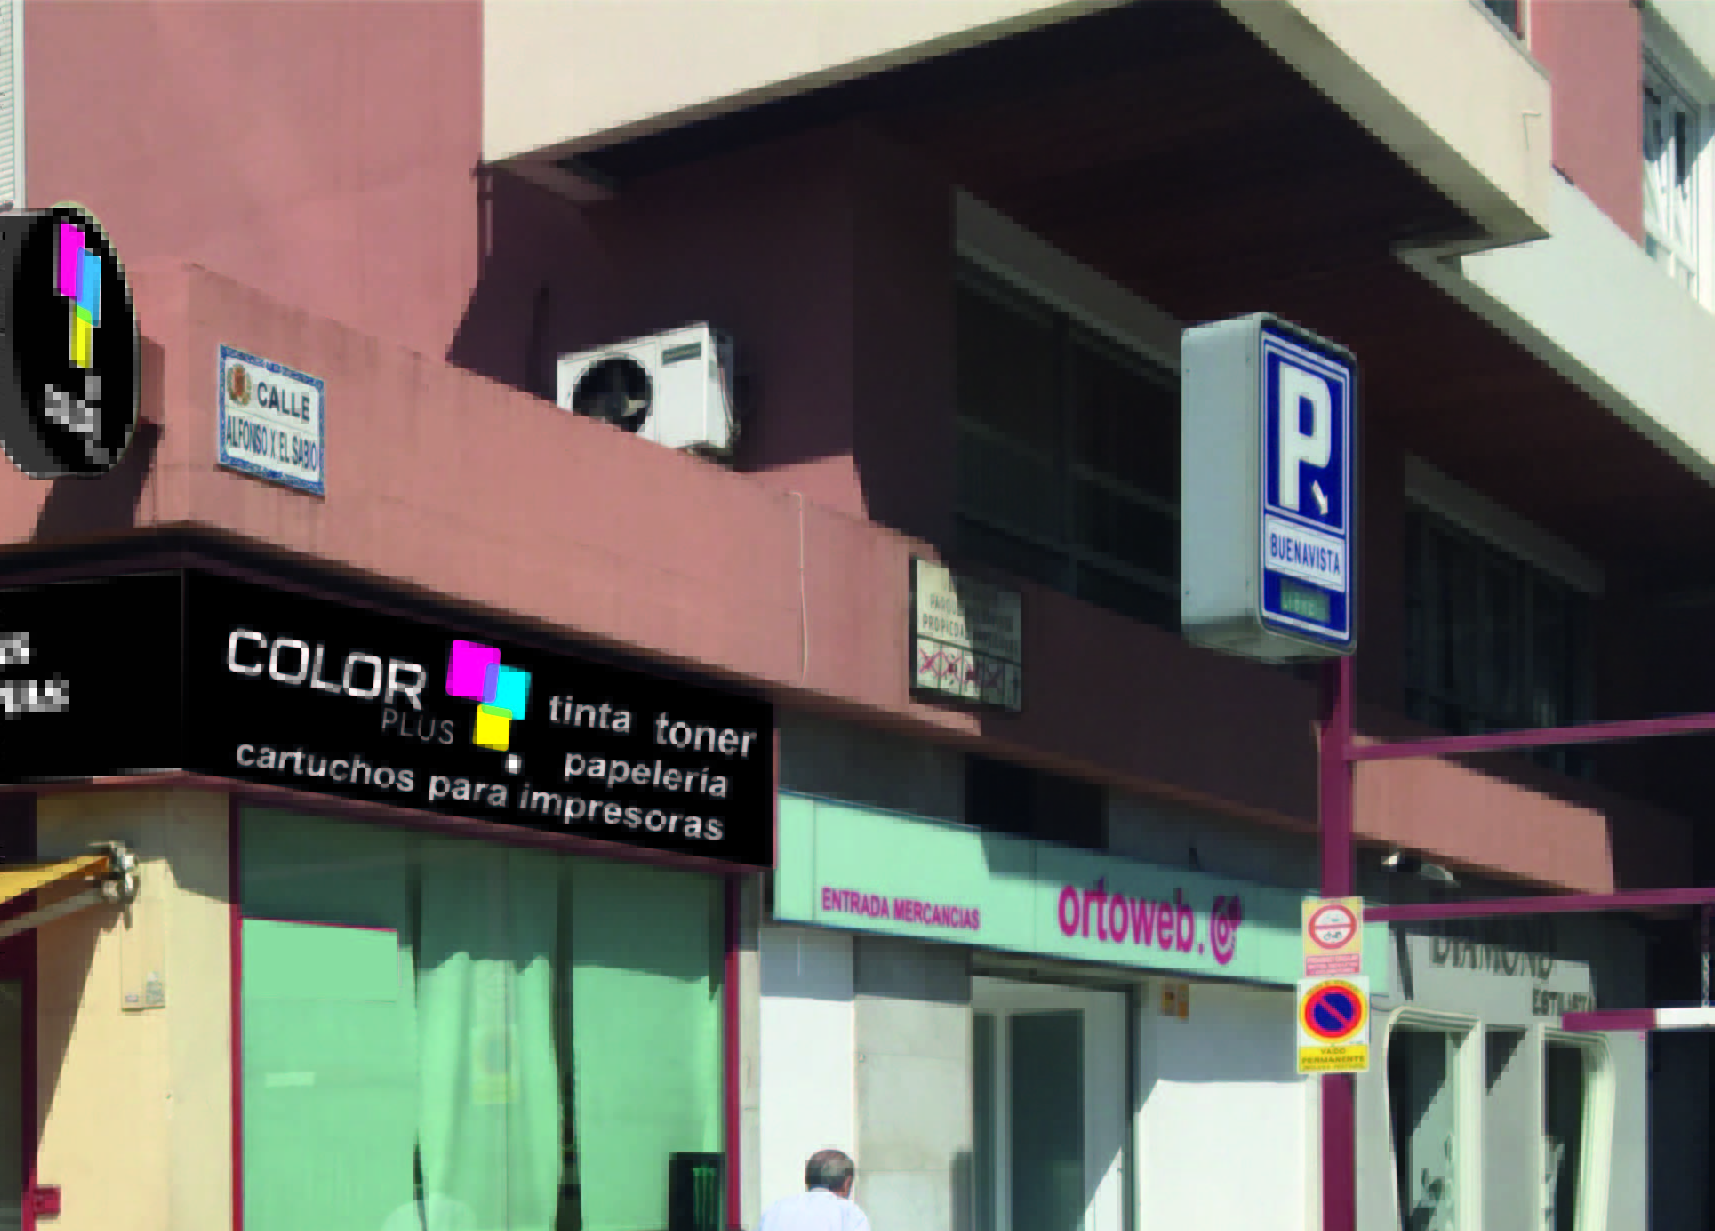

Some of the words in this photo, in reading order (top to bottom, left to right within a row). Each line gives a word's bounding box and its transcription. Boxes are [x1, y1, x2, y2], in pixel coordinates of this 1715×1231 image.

[256, 381, 310, 423] CALLE
[226, 415, 268, 457] ALFONSO
[279, 431, 290, 463] EL
[292, 435, 318, 472] SABIO
[1278, 361, 1333, 512] P
[1270, 532, 1341, 577] BUENAVISTA
[225, 626, 427, 710] COLOR
[380, 708, 455, 746] PLUS
[548, 693, 632, 735] tinta
[654, 710, 758, 760] toner
[235, 741, 415, 793] cartuchos
[428, 772, 508, 809] para
[519, 781, 725, 843] impresoras
[821, 886, 889, 920] ENTRADA
[893, 898, 981, 932] MERCANCIAS
[1301, 1055, 1366, 1065] PERMANENTE
[1320, 1047, 1347, 1056] VADO
